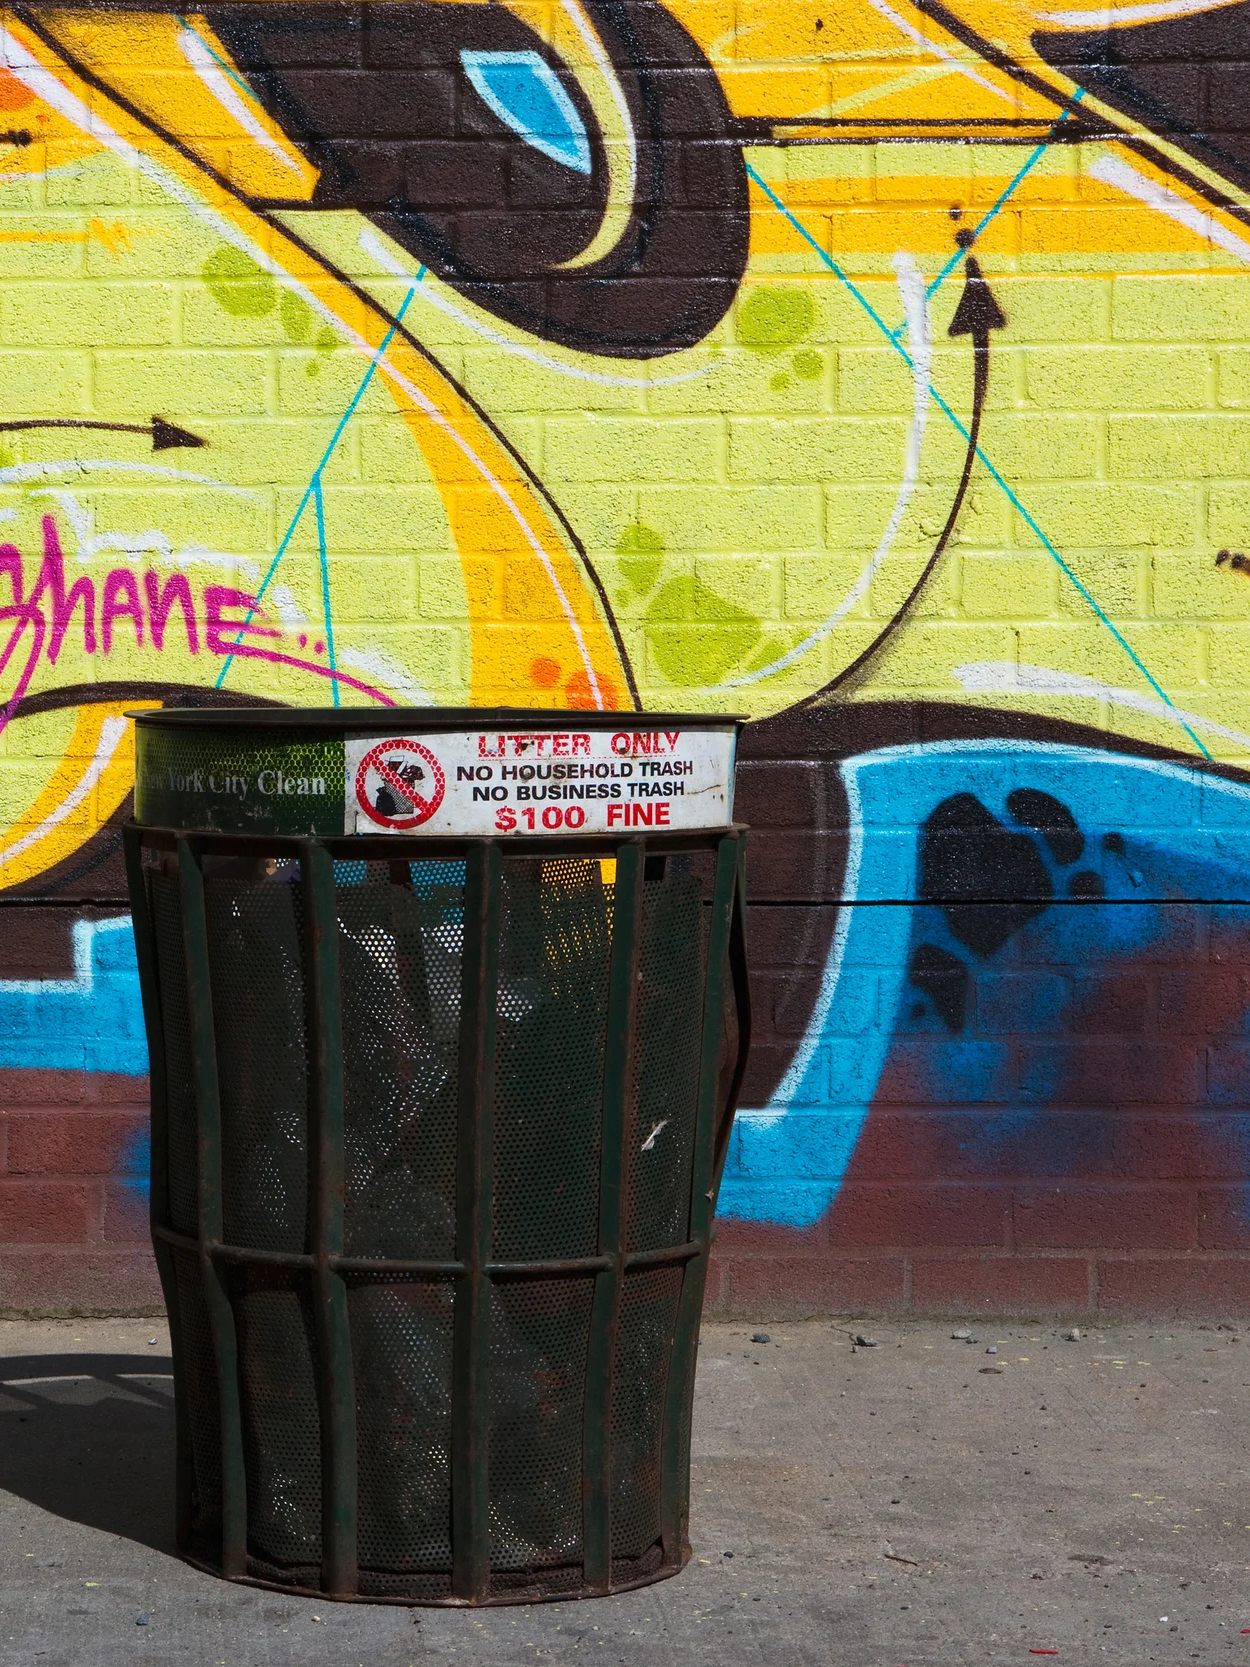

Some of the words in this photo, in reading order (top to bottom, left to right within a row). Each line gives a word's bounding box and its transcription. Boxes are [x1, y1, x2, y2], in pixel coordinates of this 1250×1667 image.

[478, 735, 591, 757] LITTER
[610, 731, 680, 755] ONLY
[456, 765, 493, 781] NO
[501, 763, 633, 780] HOUSEHOLD
[641, 760, 693, 777] TRASH
[168, 767, 204, 793] York
[208, 769, 250, 801] City
[257, 769, 326, 796] Clean
[472, 786, 508, 801] NO
[516, 783, 621, 800] BUSINESS
[627, 781, 684, 797] TRASH
[494, 805, 585, 832] $100
[607, 802, 670, 827] FINE
